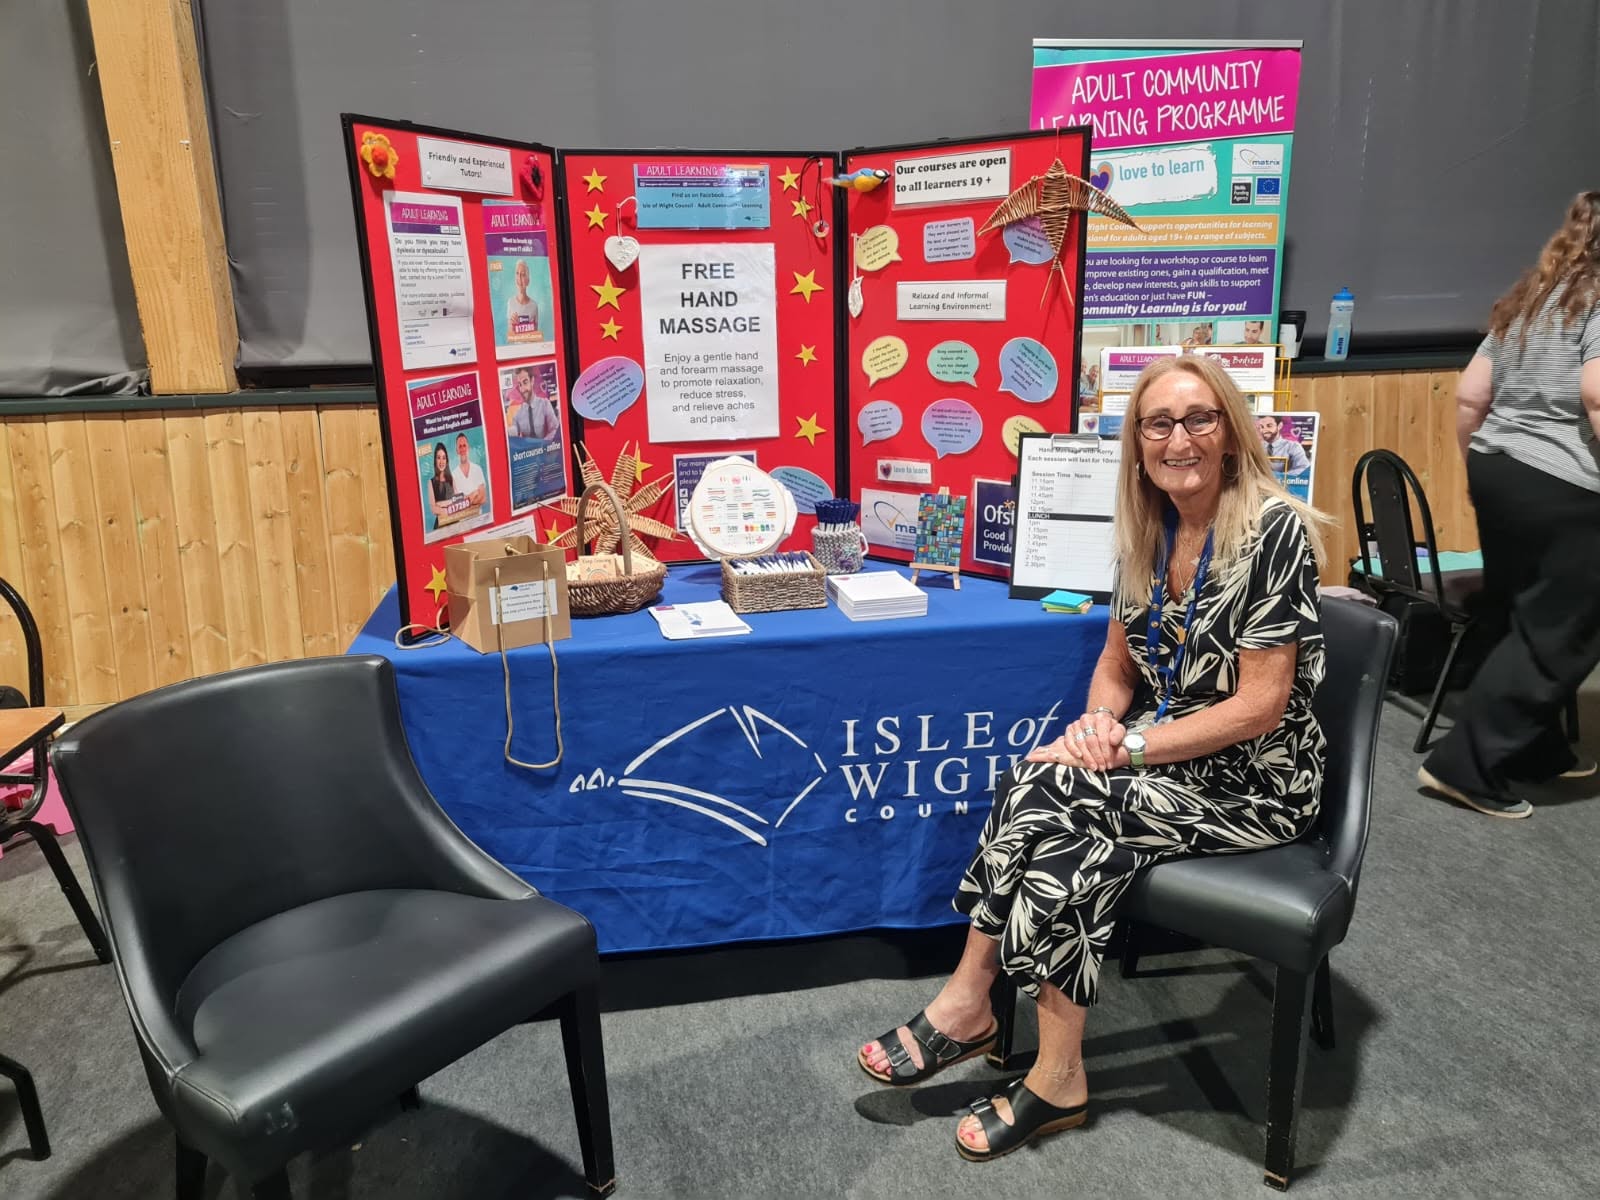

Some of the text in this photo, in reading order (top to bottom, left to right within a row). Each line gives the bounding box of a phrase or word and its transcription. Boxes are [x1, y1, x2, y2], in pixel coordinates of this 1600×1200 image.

[1071, 60, 1263, 105] ADULT COMMUNITY
[1157, 95, 1286, 133] PROGRAMME
[428, 152, 456, 164] Friendly
[472, 158, 505, 169] Experienced
[896, 156, 1007, 175] Our courses are open
[460, 168, 482, 178] Tutors!
[646, 166, 718, 176] ADULT LEARNING
[1119, 158, 1205, 182] love to learn
[896, 182, 907, 193] to
[908, 180, 922, 192] all
[924, 177, 968, 191] learners
[970, 176, 983, 188] 19
[402, 208, 448, 221] ADULT LEARNING
[492, 213, 540, 228] ADULT LEARNING
[1174, 221, 1228, 231] opportunities
[1229, 221, 1241, 230] for
[1087, 234, 1108, 242] sland
[1110, 256, 1140, 268] looking
[1141, 256, 1152, 265] for
[1160, 256, 1200, 266] workshop
[1248, 254, 1268, 262] learn
[682, 262, 736, 280] FREE
[1118, 268, 1149, 278] existing
[1150, 268, 1171, 278] ones,
[1172, 268, 1190, 278] gain
[1198, 266, 1249, 277] qualification,
[1250, 266, 1270, 274] meet
[1092, 281, 1124, 291] develop
[1144, 280, 1179, 290] interests,
[1180, 280, 1198, 290] gain
[1200, 278, 1220, 287] skills
[1220, 279, 1230, 287] to
[1230, 279, 1261, 288] support
[680, 291, 738, 308] HAND
[912, 292, 940, 300] Relaxed
[941, 291, 956, 300] and
[1100, 293, 1140, 302] education
[1150, 292, 1165, 302] just
[1166, 292, 1186, 300] have
[1187, 292, 1206, 300] FUN
[909, 302, 992, 312] Learning Environment!
[1083, 300, 1247, 316] ommunity Learning is for you!
[660, 316, 761, 334] MASSAGE
[664, 353, 691, 364] Enjoy
[703, 352, 732, 364] gentle
[735, 352, 758, 360] hand
[1120, 354, 1136, 362] ADULT
[660, 364, 764, 376] and forearm massage
[661, 376, 764, 390] to promote relaxation,
[416, 384, 472, 410] ADULT LEARNING
[680, 390, 747, 400] reduce stress,
[672, 400, 756, 412] and relieve aches
[690, 415, 708, 424] and
[512, 441, 560, 462] short courses online
[893, 465, 906, 474] love
[913, 466, 928, 474] learn
[984, 504, 1015, 525] Ofst
[983, 529, 1006, 541] Good
[983, 540, 1012, 554] Provid
[842, 700, 1064, 756] ISLE of
[839, 754, 1022, 800] WIGH
[844, 802, 968, 822] COUN
